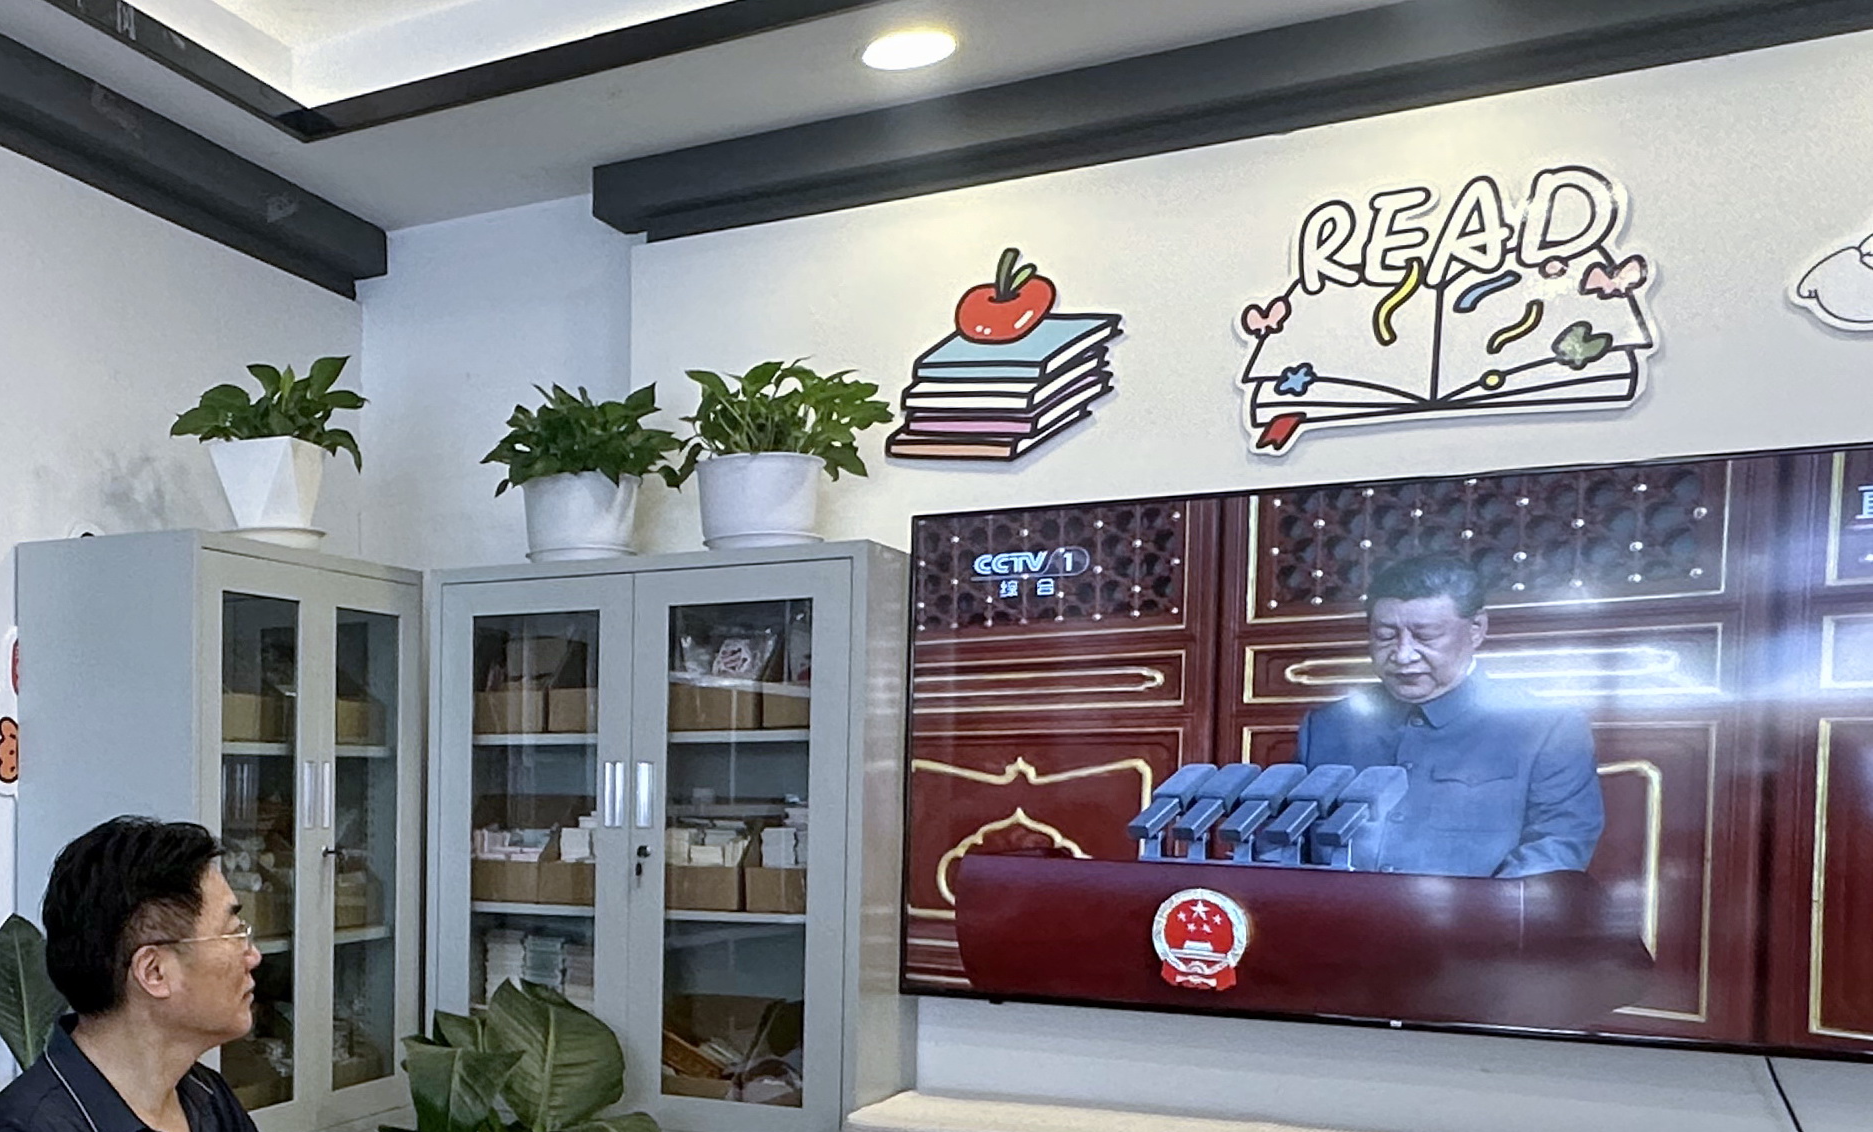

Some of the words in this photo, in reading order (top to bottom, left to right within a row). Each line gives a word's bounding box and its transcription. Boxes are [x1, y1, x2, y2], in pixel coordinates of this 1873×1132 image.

[1300, 165, 1621, 294] READ
[973, 551, 1048, 575] CCTV
[1063, 551, 1073, 572] 1
